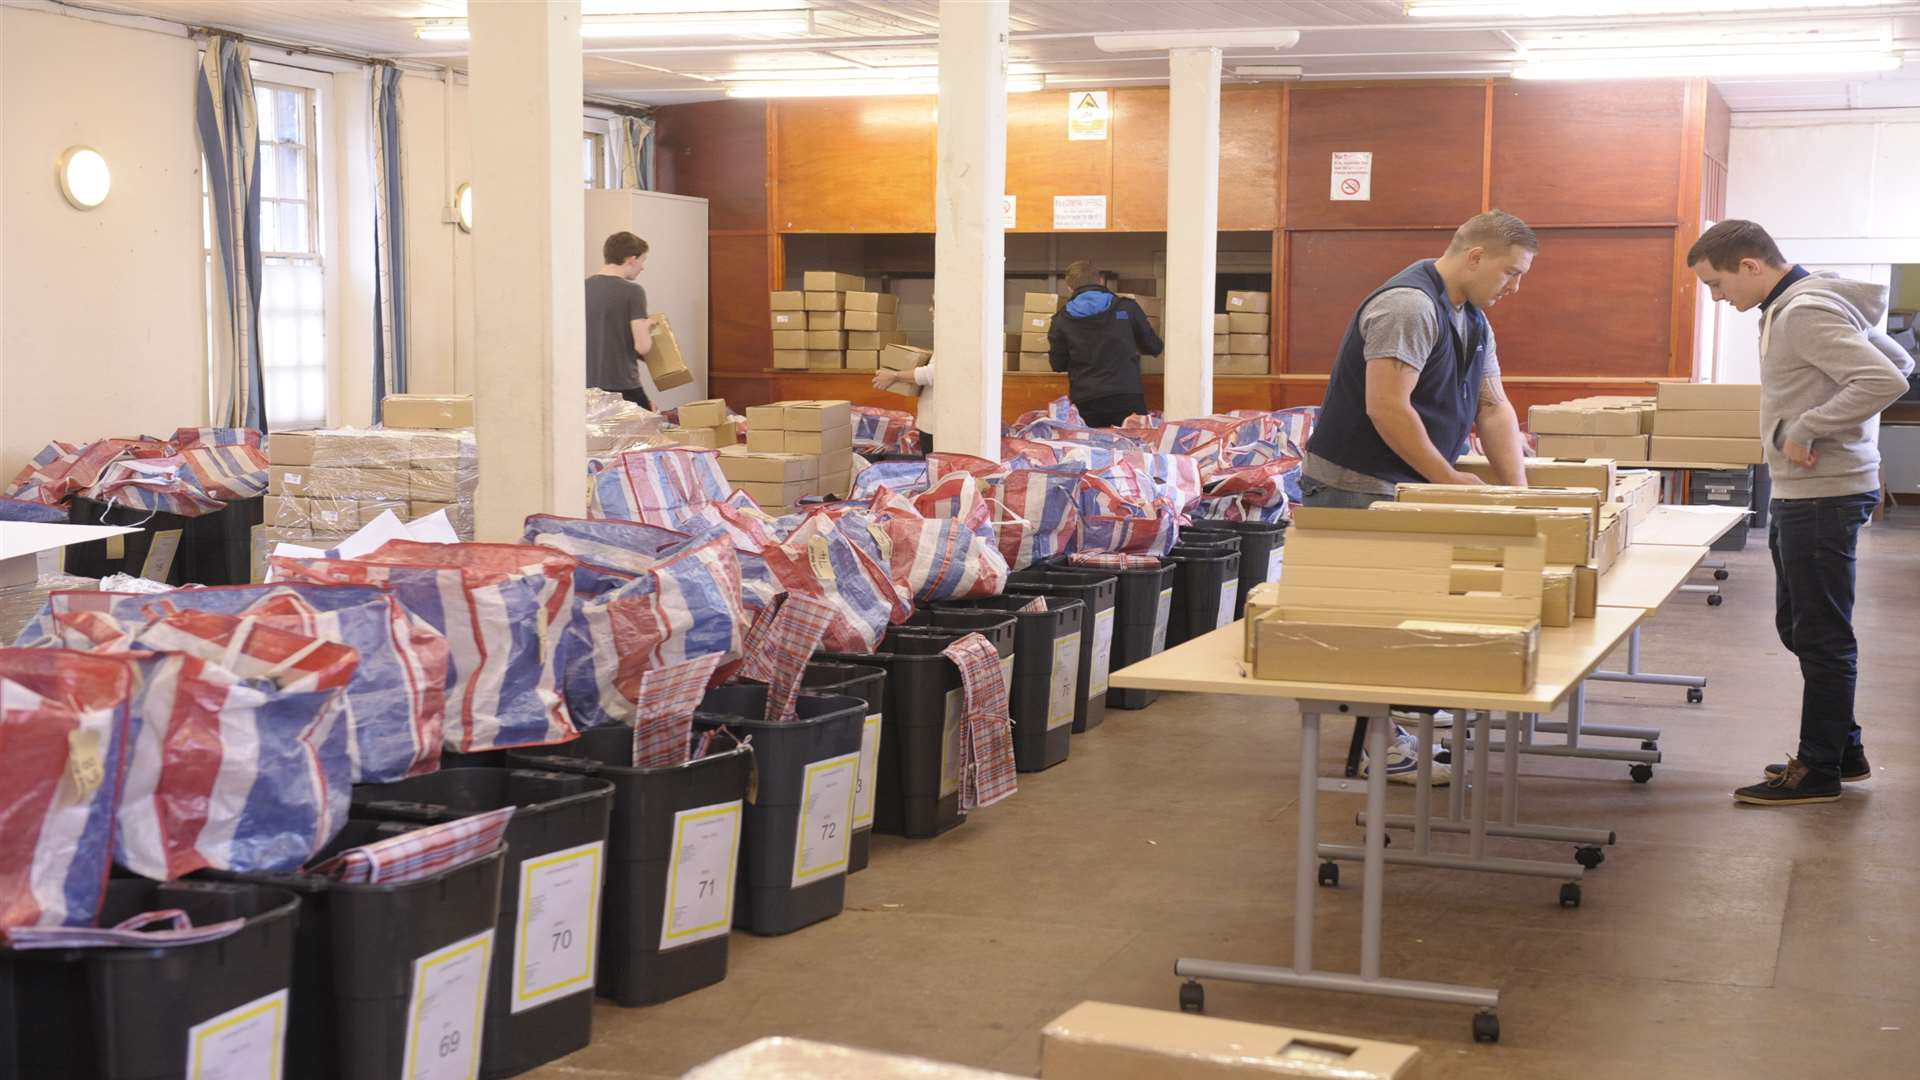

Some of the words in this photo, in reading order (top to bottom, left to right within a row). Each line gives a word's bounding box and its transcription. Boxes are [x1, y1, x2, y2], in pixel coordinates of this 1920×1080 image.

[855, 778, 863, 794] 3
[821, 822, 837, 841] 72
[698, 878, 715, 900] 71
[551, 929, 573, 953] 70
[439, 1030, 461, 1058] 69
